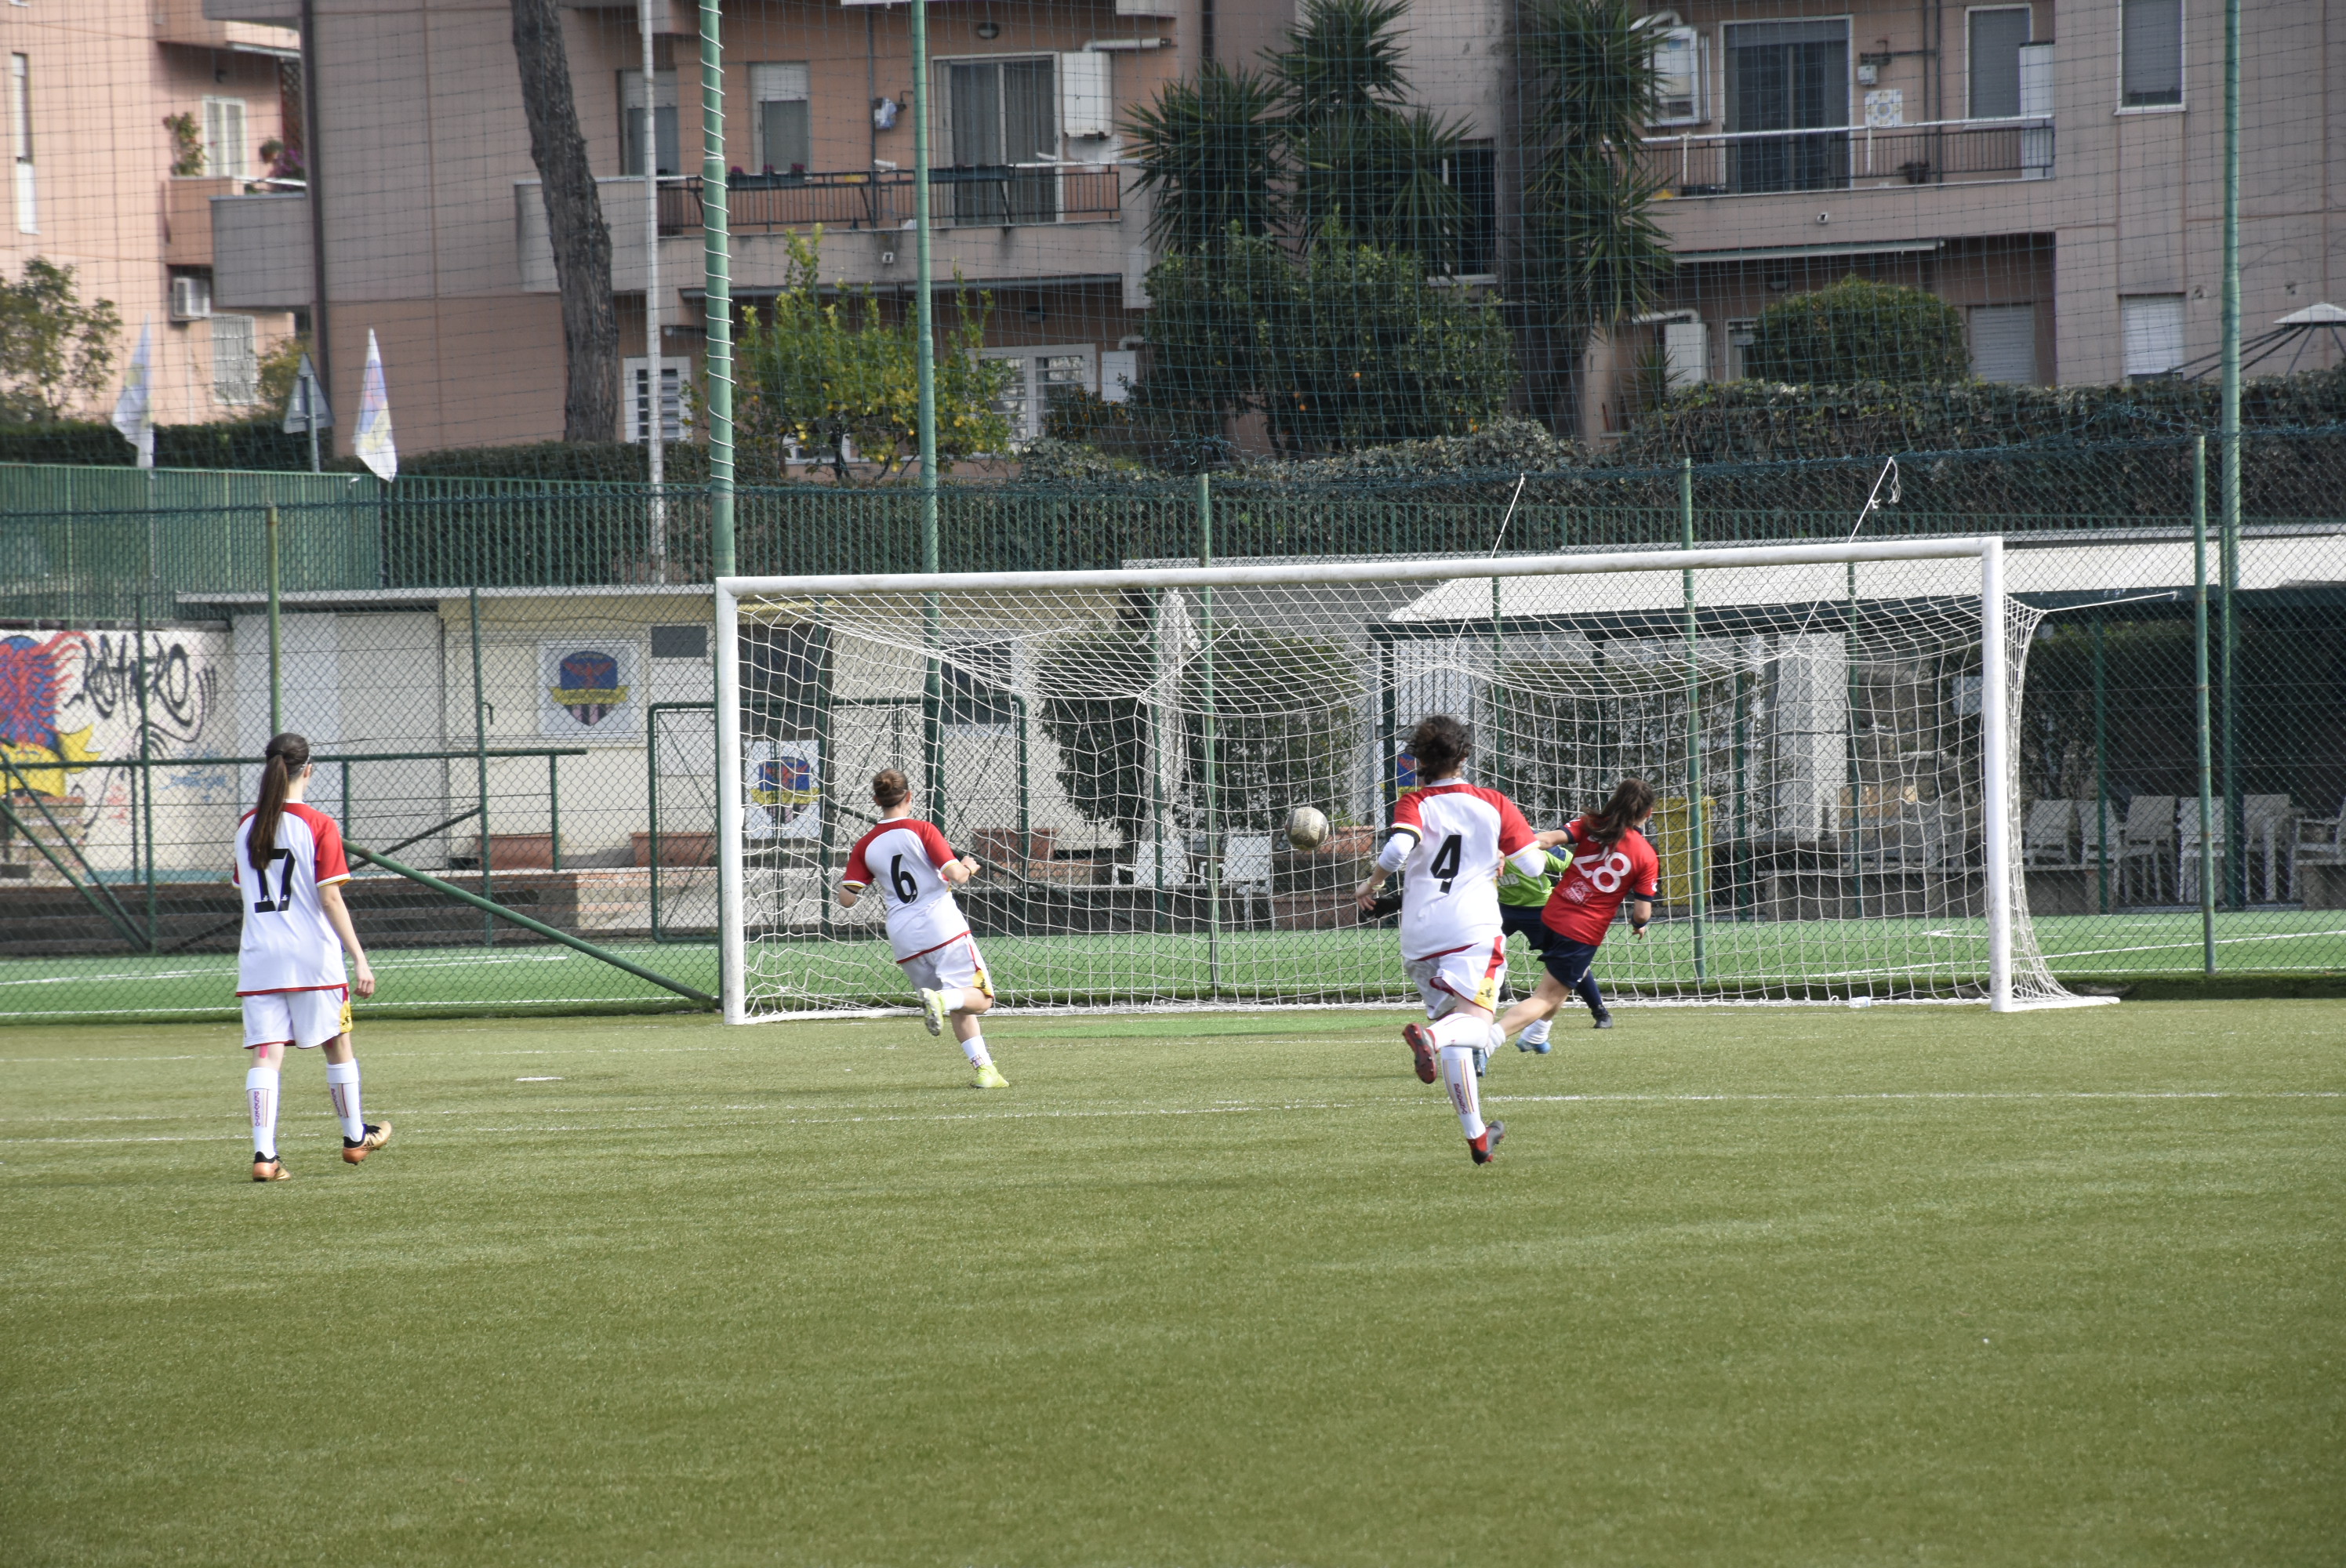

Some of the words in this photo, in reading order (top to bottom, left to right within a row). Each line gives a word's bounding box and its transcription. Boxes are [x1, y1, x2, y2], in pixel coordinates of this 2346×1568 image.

[254, 848, 296, 913] 17
[891, 854, 918, 904] 6
[1430, 835, 1462, 895] 4
[1573, 846, 1632, 893] 28
